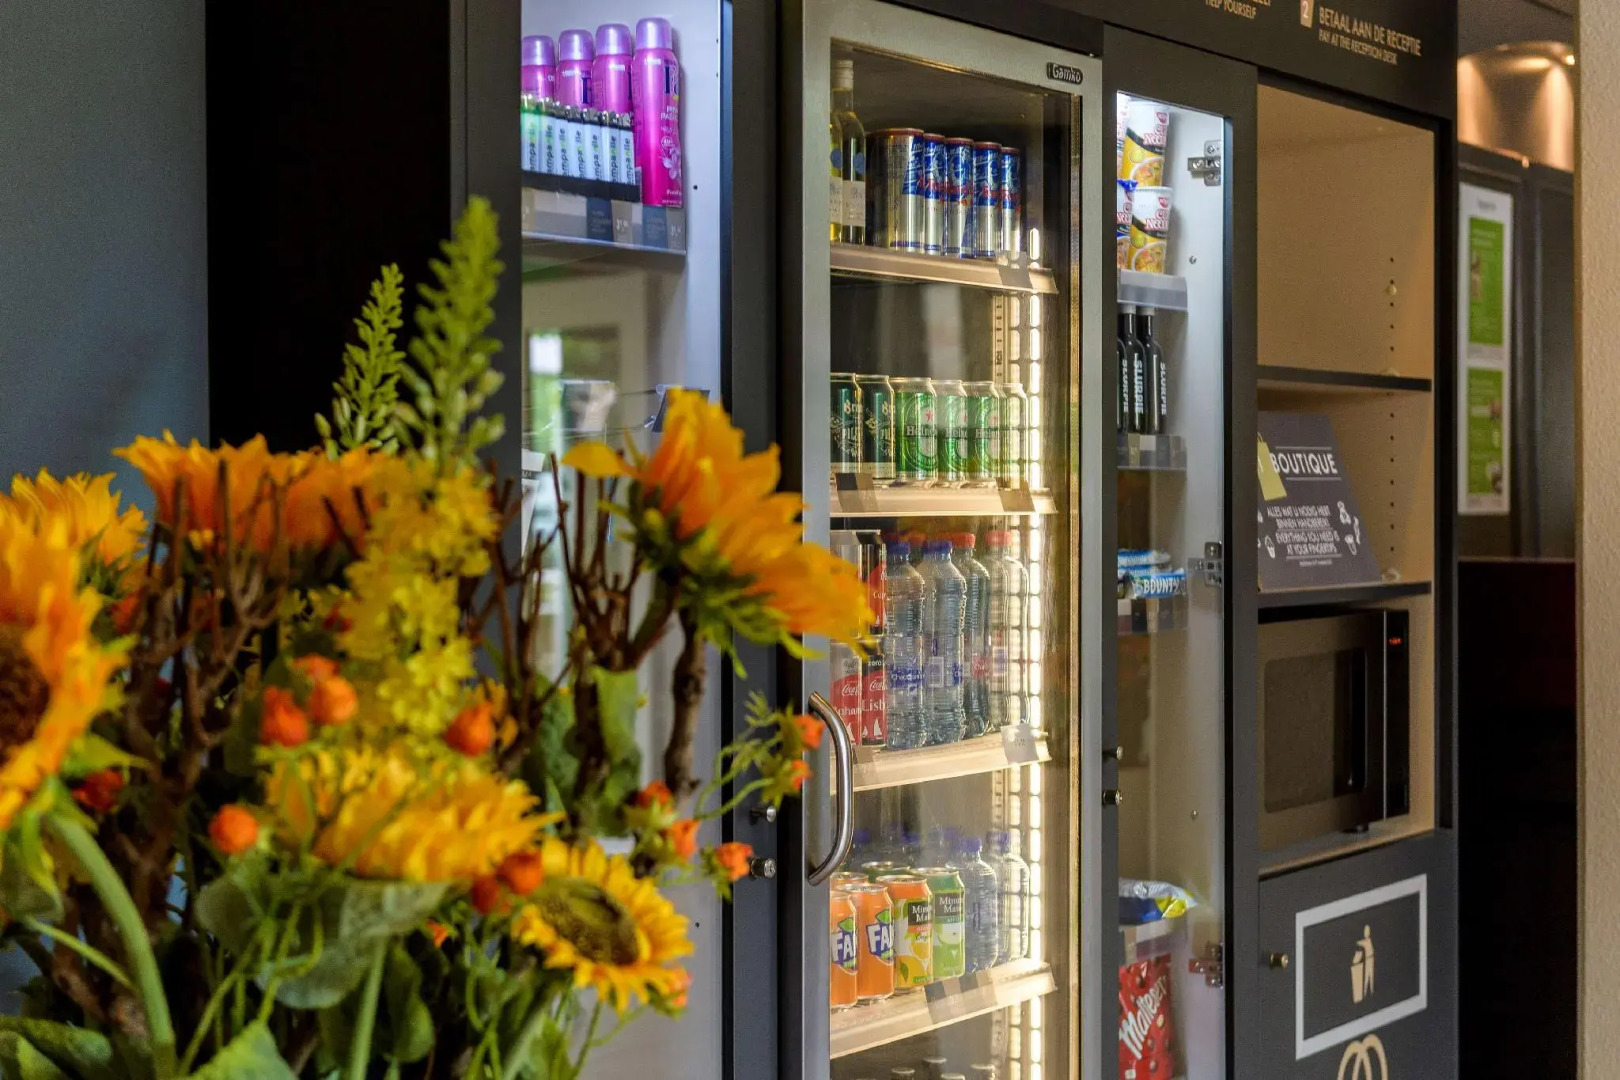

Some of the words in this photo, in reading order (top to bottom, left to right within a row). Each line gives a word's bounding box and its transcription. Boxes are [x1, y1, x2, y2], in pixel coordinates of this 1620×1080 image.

[1223, 0, 1256, 19] YOURSELF
[1302, 0, 1309, 19] 2
[1319, 6, 1350, 33] BETAAL
[1352, 17, 1372, 40] AAN
[1374, 24, 1385, 44] DE
[1387, 29, 1422, 56] RECEPTIE
[906, 425, 937, 437] Heine
[1269, 452, 1338, 475] BOUTIQUE
[1143, 576, 1180, 595] BOUNTY
[831, 931, 857, 962] FA
